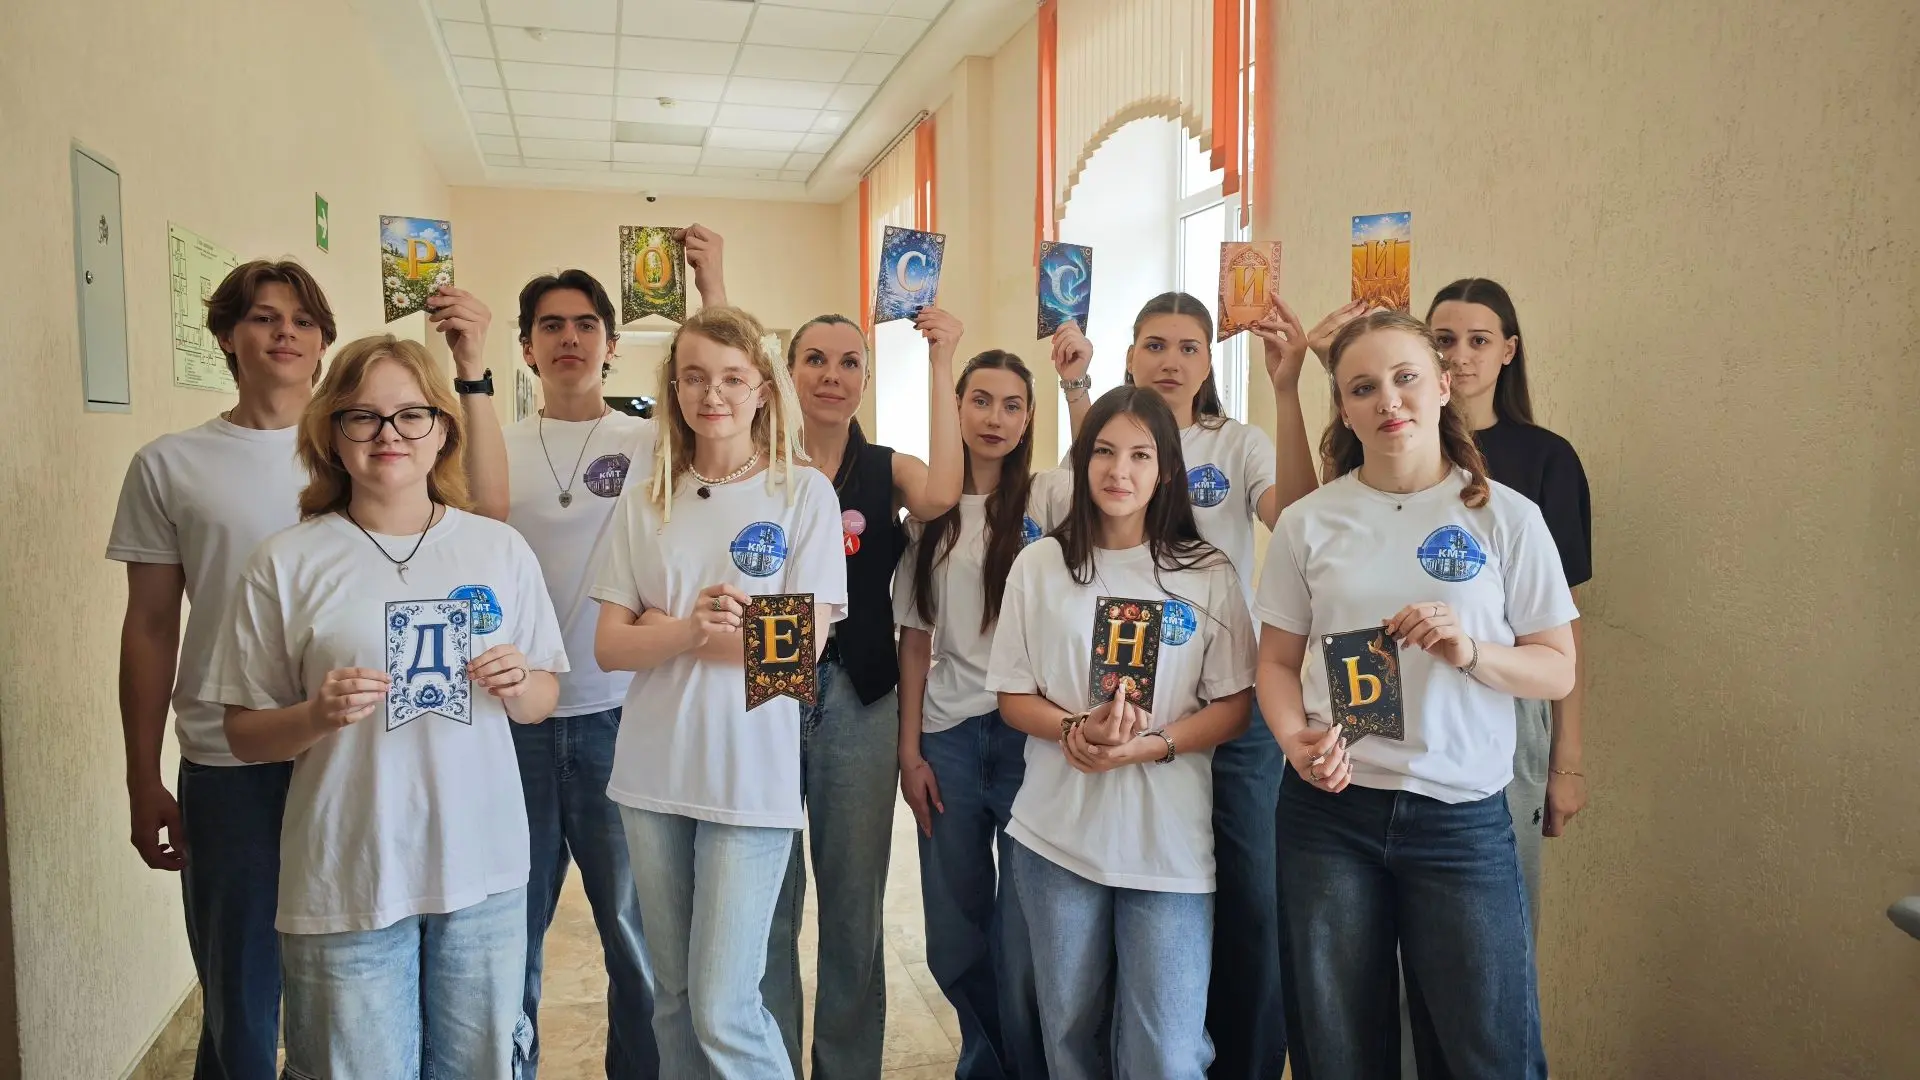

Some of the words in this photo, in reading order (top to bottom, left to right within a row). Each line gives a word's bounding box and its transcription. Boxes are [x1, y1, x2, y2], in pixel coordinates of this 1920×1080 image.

[405, 238, 436, 280] Р
[635, 246, 671, 291] О
[896, 250, 927, 293] С
[1364, 238, 1398, 282] И
[1050, 264, 1080, 307] С
[1232, 265, 1268, 307] И
[599, 470, 621, 479] КМТ
[1194, 481, 1216, 489] КМТ
[747, 542, 775, 554] КМТ
[1438, 548, 1468, 559] КМТ
[472, 603, 491, 612] МТ
[1162, 616, 1185, 626] КМТ
[406, 623, 451, 684] Д
[759, 615, 800, 664] Е
[1103, 619, 1149, 667] Н
[1342, 655, 1382, 706] Ь
